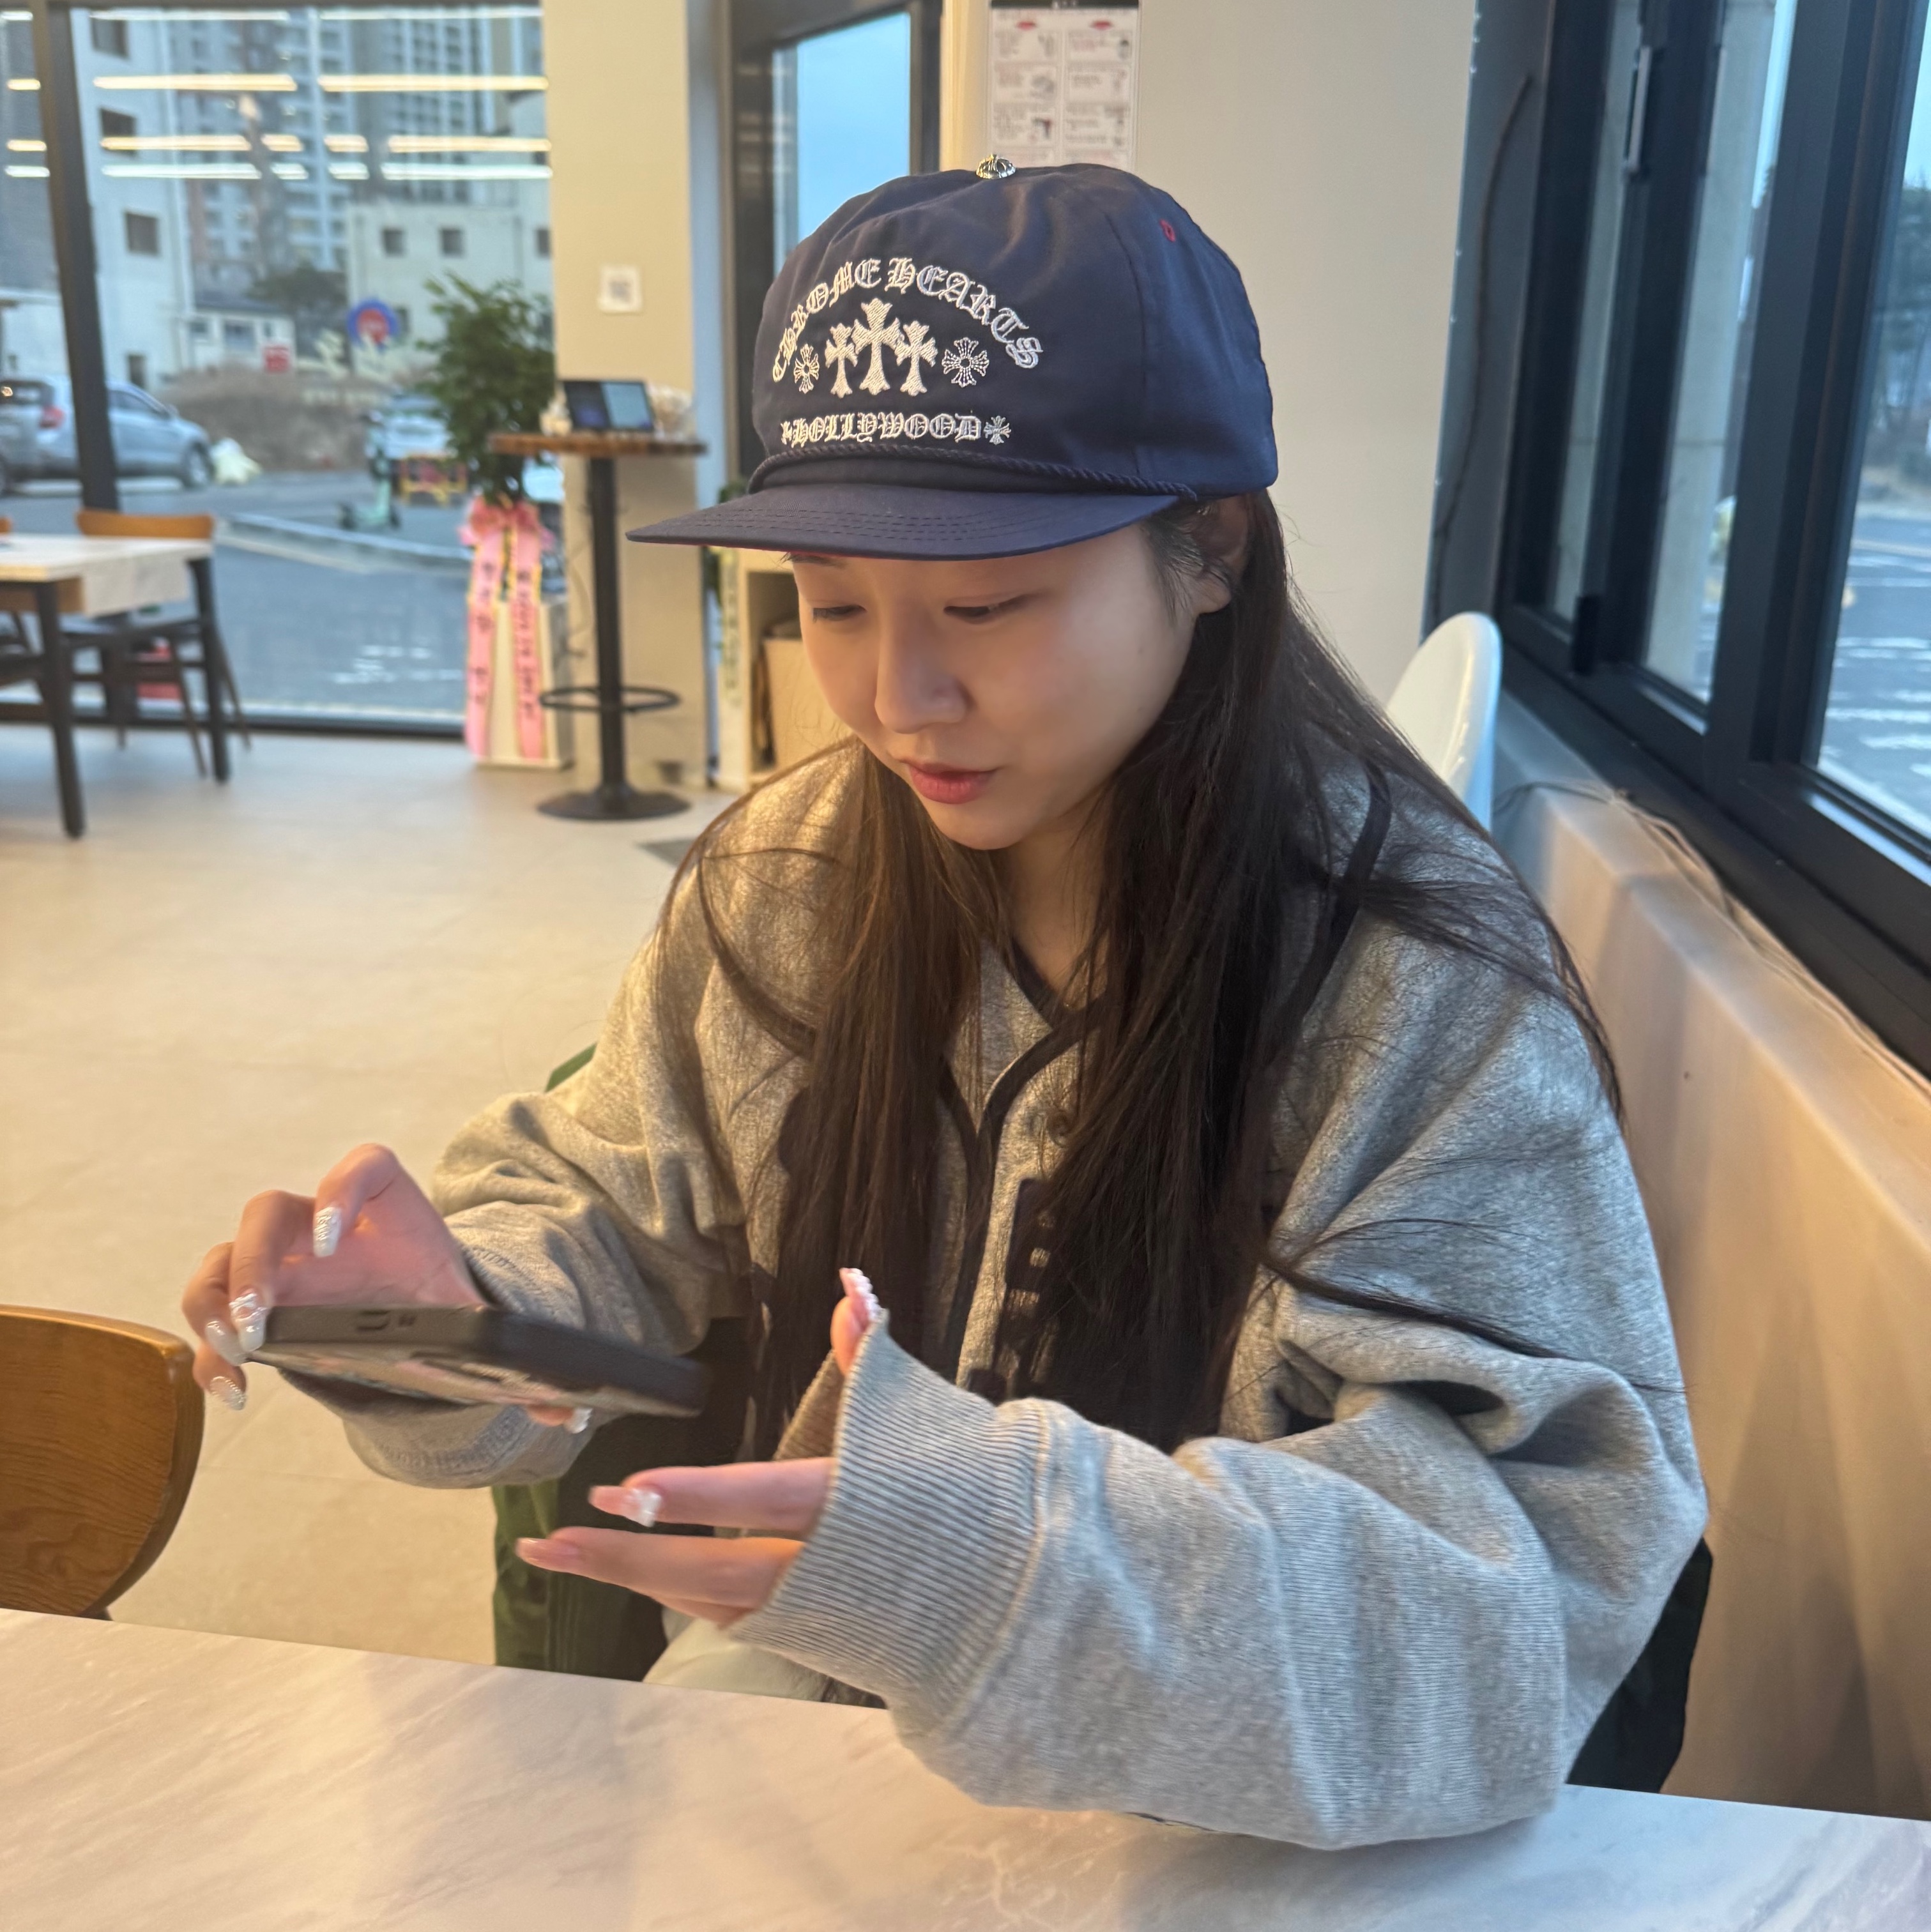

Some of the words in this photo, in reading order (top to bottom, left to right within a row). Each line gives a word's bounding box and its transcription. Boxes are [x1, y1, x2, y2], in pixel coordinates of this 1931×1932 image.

[772, 257, 882, 383] CHROME
[884, 257, 1043, 369] HEARTS
[791, 412, 982, 448] HOLLYWOOD
